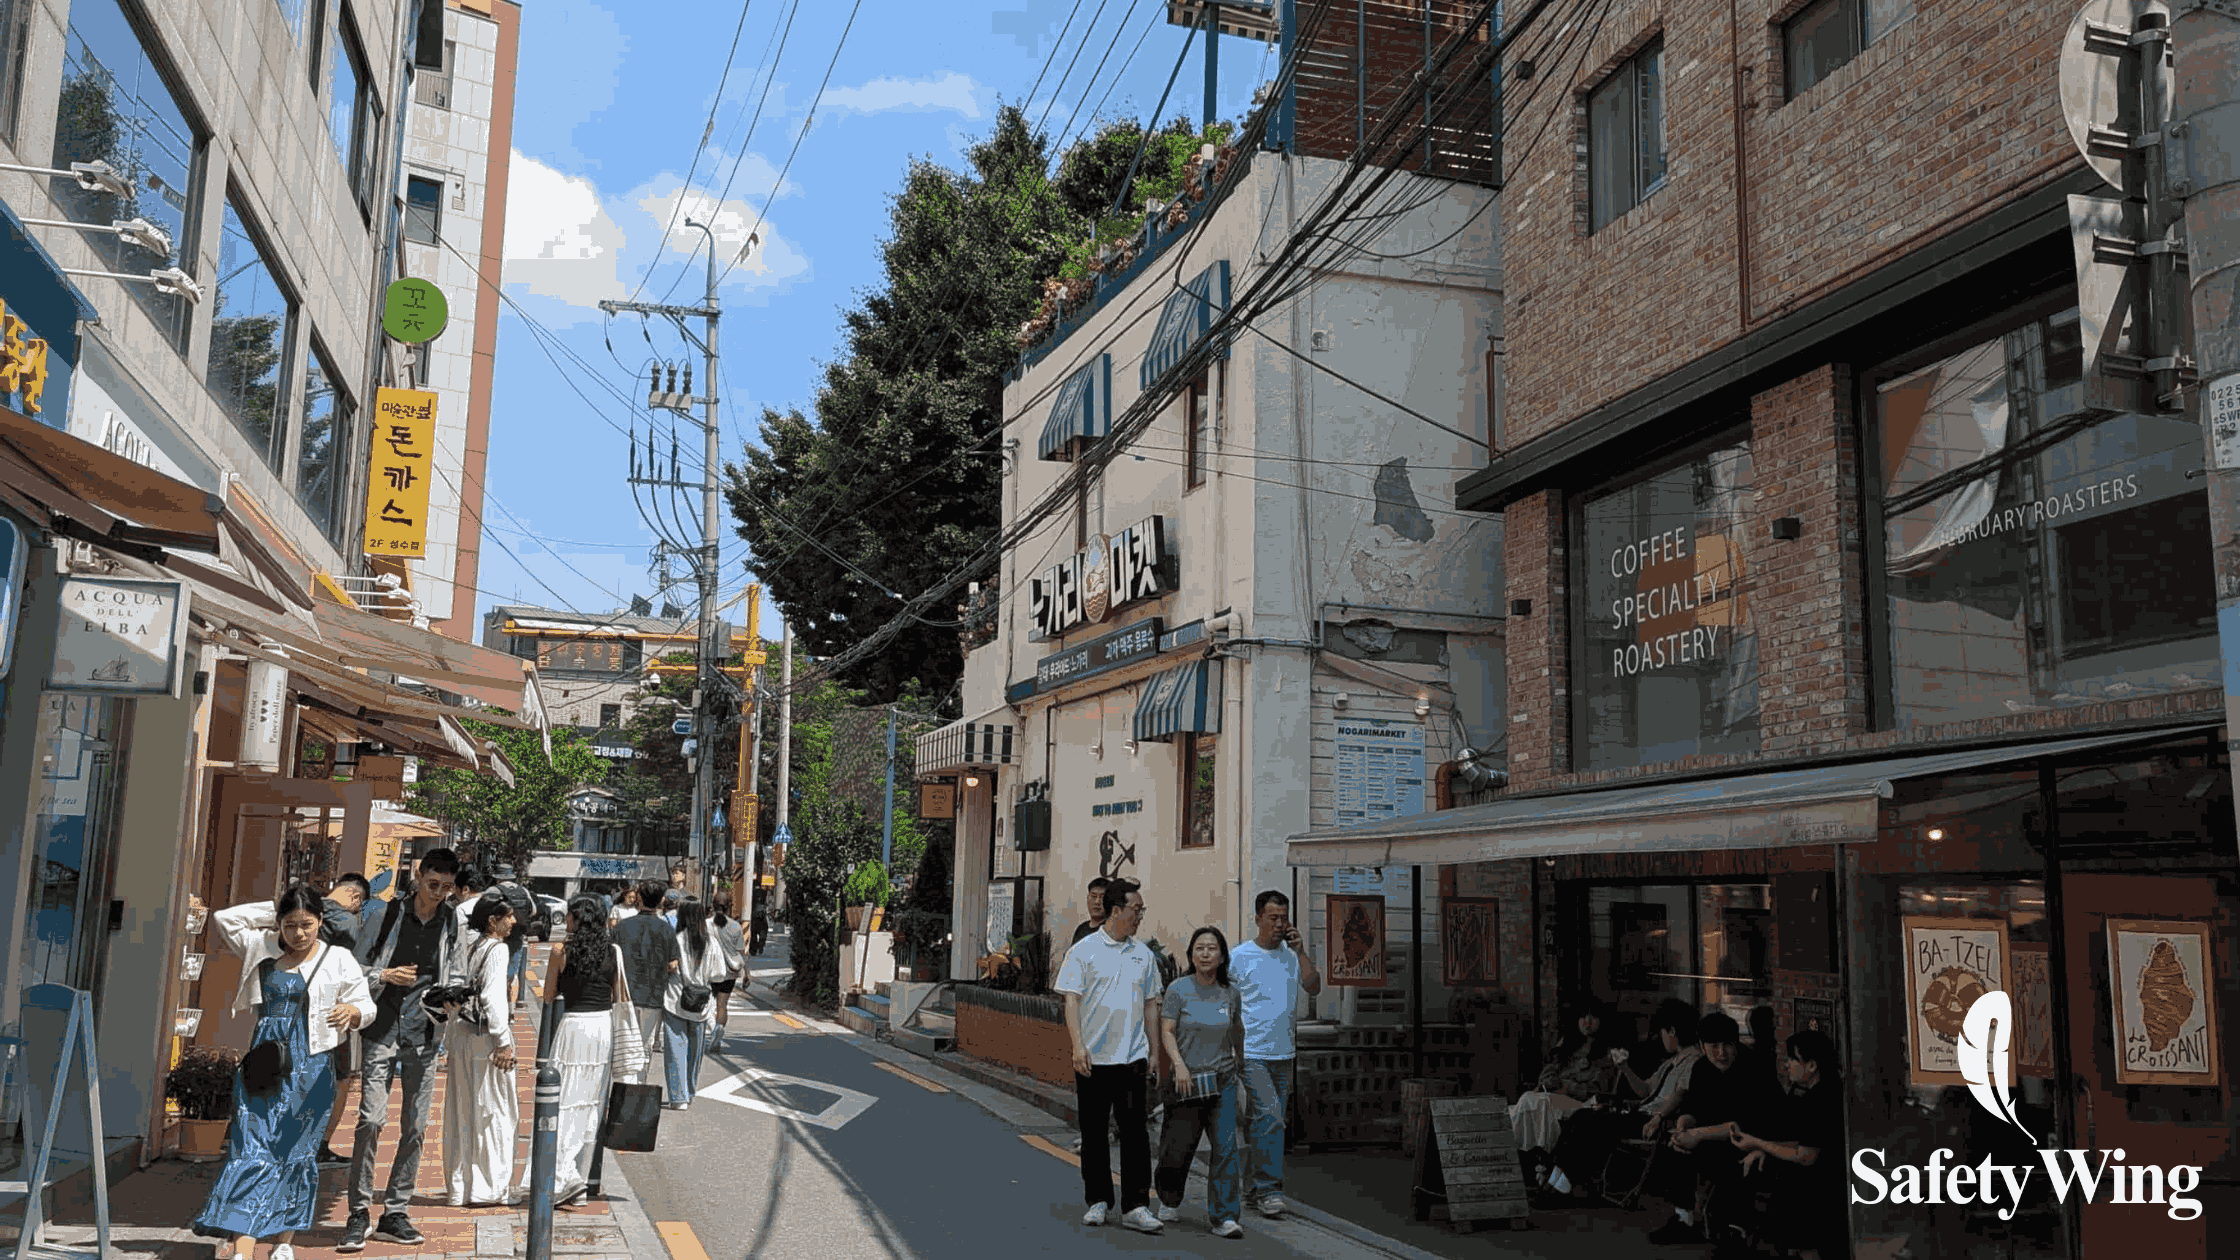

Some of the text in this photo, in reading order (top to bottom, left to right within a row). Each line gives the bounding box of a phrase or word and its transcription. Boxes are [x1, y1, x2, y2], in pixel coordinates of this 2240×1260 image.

[379, 424, 423, 527] 돈카스
[2034, 474, 2137, 523] ROASTERS
[369, 539, 384, 548] 2F
[1611, 526, 1686, 578] COFFEE
[74, 589, 163, 606] ACQUA
[1028, 514, 1158, 642] 노가리 마켓
[1612, 570, 1719, 630] SPECIALTY
[84, 621, 148, 635] ELBA
[1613, 624, 1719, 678] ROASTERY
[1337, 726, 1407, 739] NOGARIMARKET
[1919, 935, 1997, 984] BA-TZEL
[2128, 1026, 2147, 1043] Le
